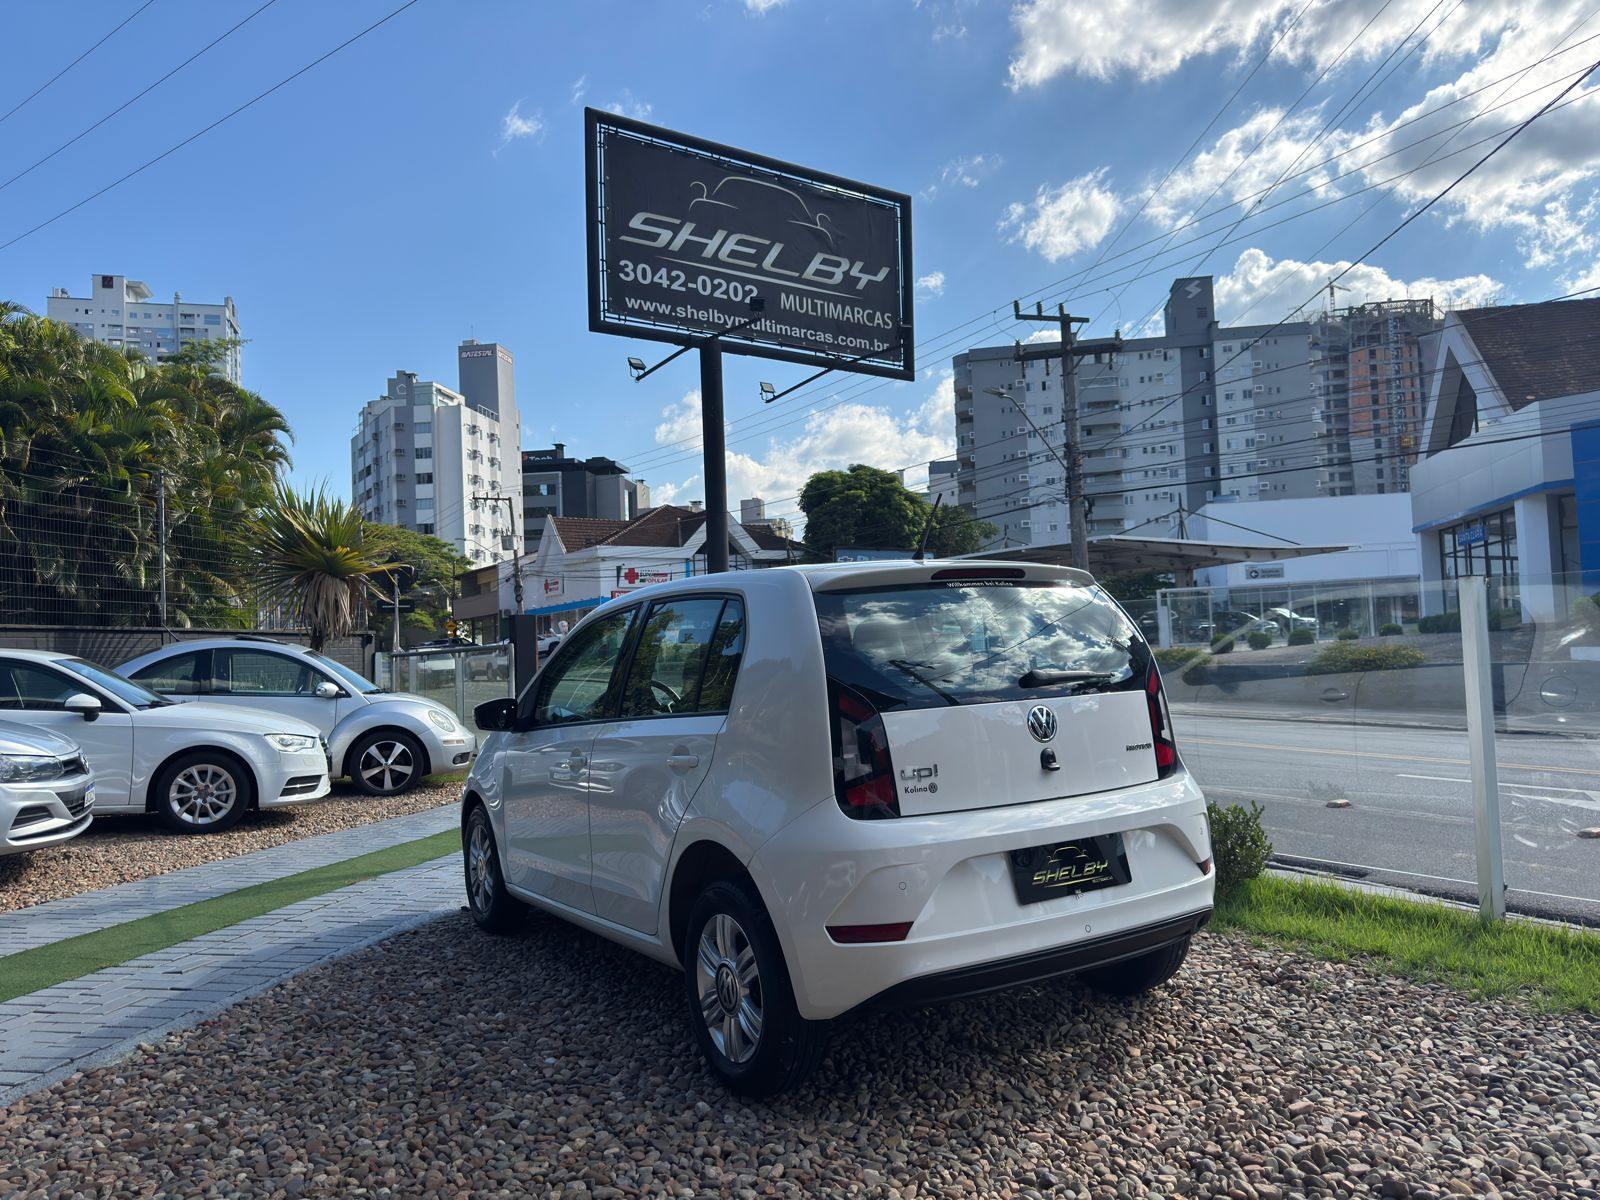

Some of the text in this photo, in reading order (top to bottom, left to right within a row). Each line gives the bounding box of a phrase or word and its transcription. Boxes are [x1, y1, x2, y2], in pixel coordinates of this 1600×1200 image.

[618, 211, 890, 290] SHELBY
[619, 259, 758, 304] 3042-0202
[780, 292, 893, 330] MULTIMARCAS
[901, 763, 938, 782] up!
[904, 785, 928, 794] Kolina
[1031, 860, 1109, 886] SHELBY
